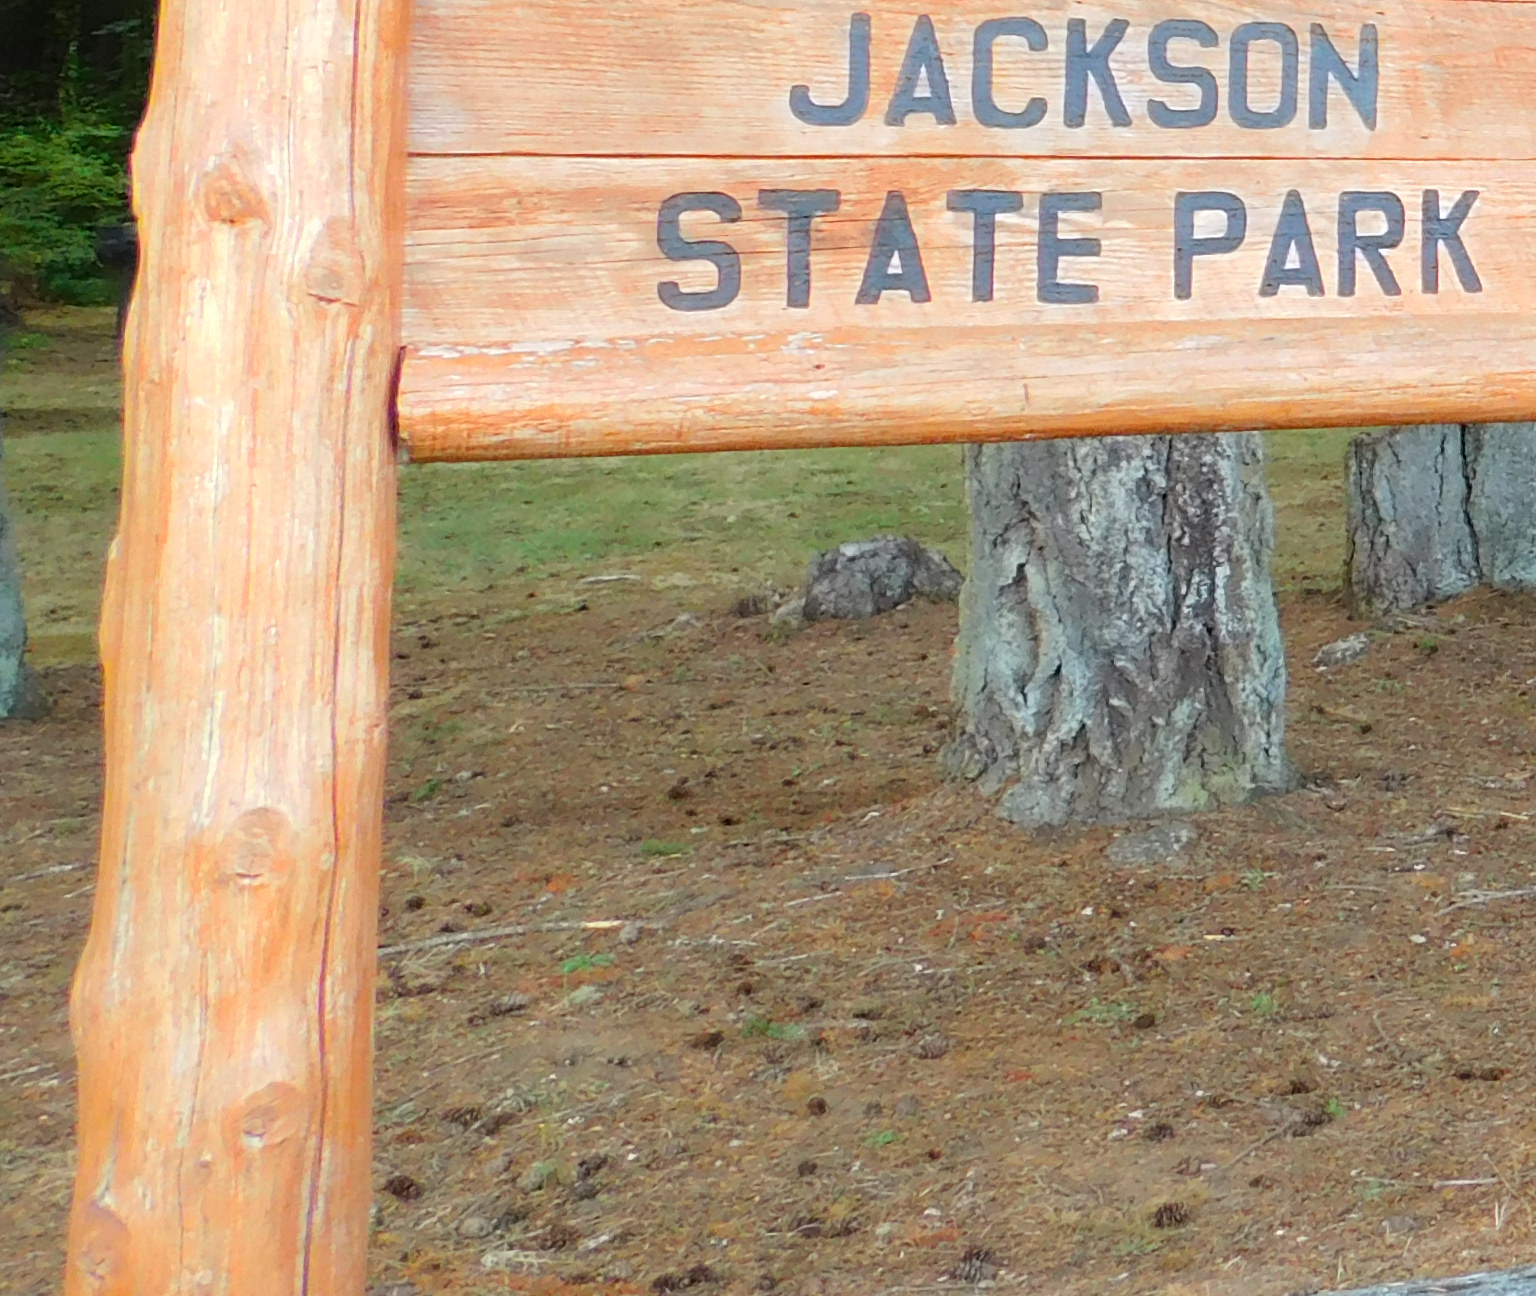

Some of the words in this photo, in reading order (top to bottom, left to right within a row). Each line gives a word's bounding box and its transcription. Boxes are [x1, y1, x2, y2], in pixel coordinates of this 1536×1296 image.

[789, 13, 1380, 130] JACKSON
[657, 190, 1103, 310] STATE
[1173, 190, 1482, 299] PARK
